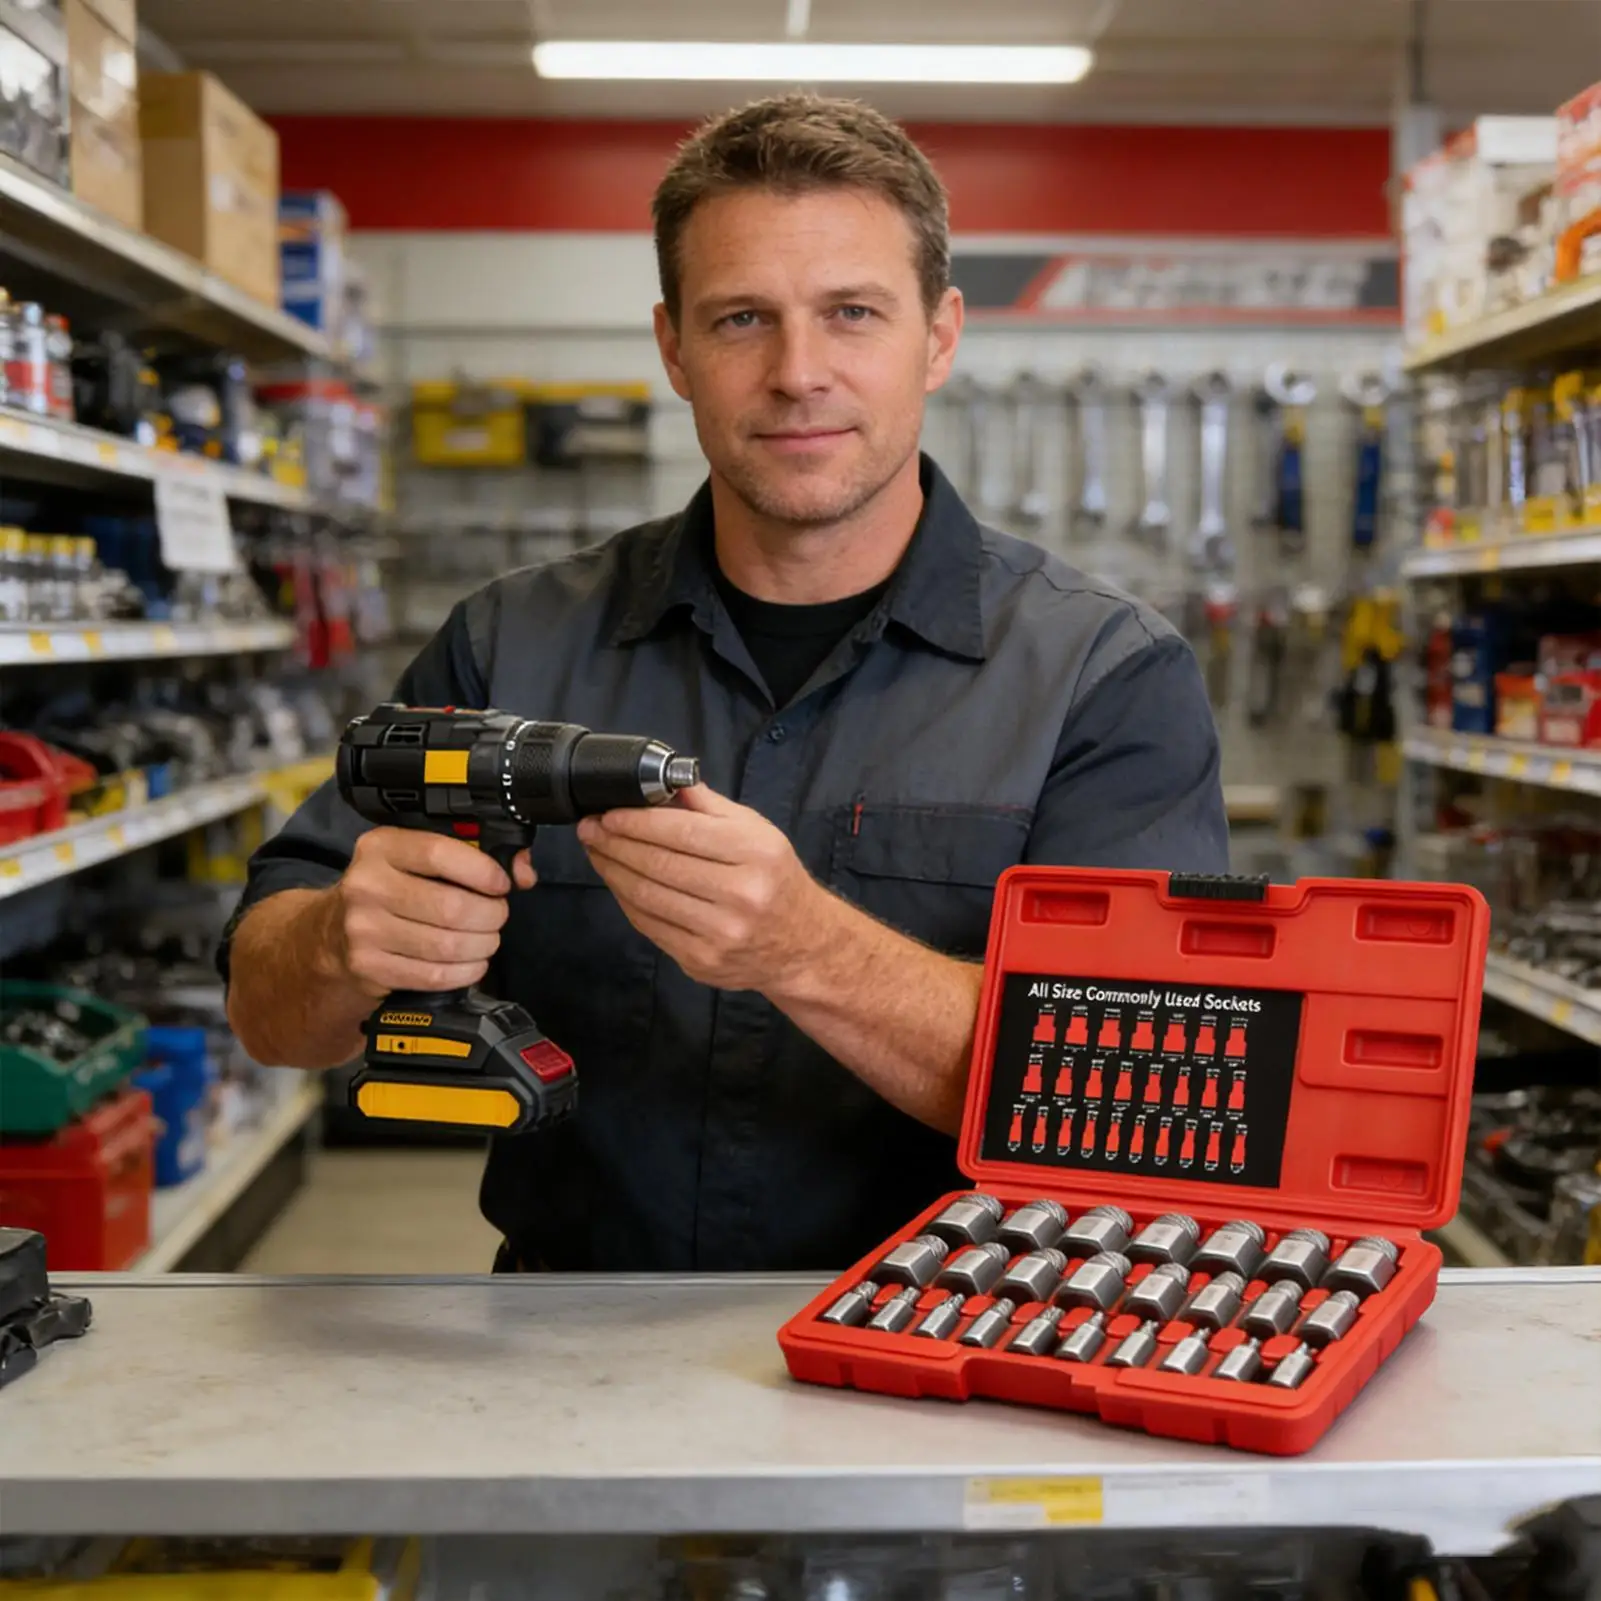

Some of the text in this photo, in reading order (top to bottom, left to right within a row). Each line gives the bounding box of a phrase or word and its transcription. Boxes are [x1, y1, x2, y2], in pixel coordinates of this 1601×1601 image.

[1028, 983, 1262, 1012] All Size Commonly Used Sockets
